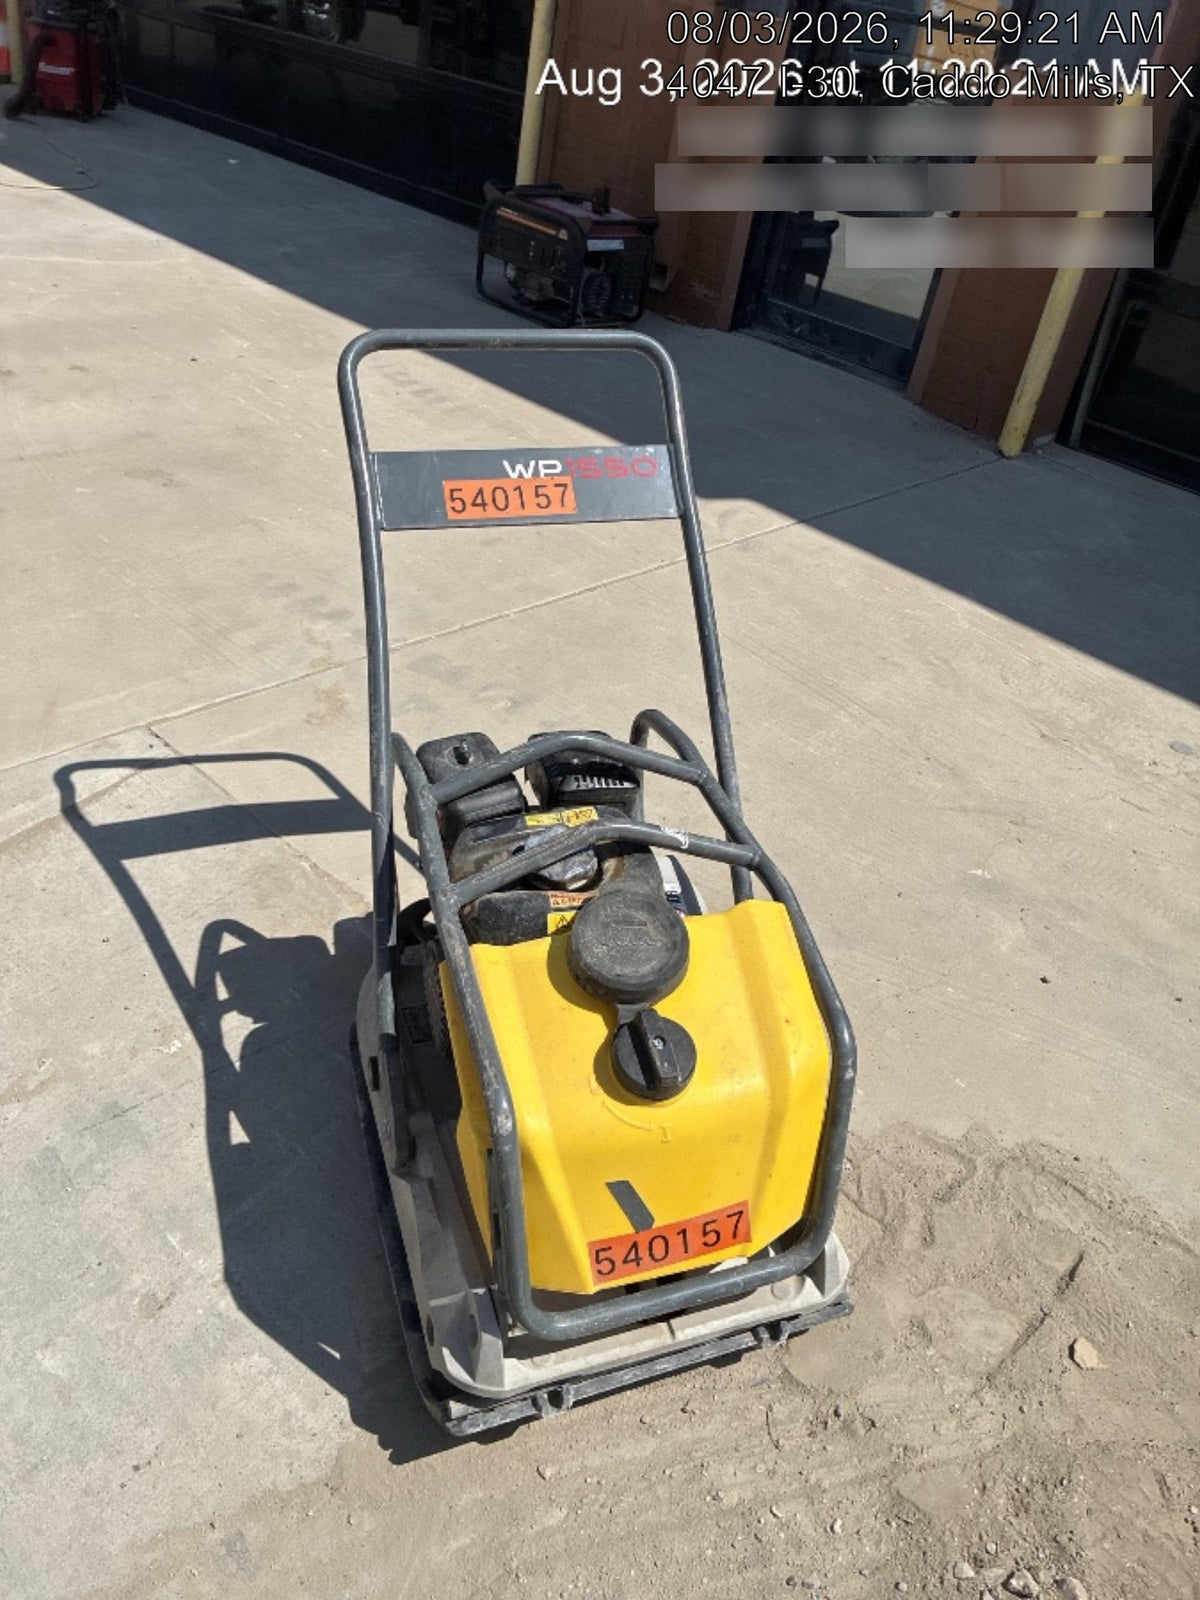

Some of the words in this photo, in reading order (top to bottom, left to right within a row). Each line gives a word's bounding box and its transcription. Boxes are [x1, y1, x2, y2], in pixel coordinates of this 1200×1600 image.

[502, 455, 659, 481] WP1550
[449, 482, 570, 514] 540157
[594, 1209, 745, 1277] 540157
